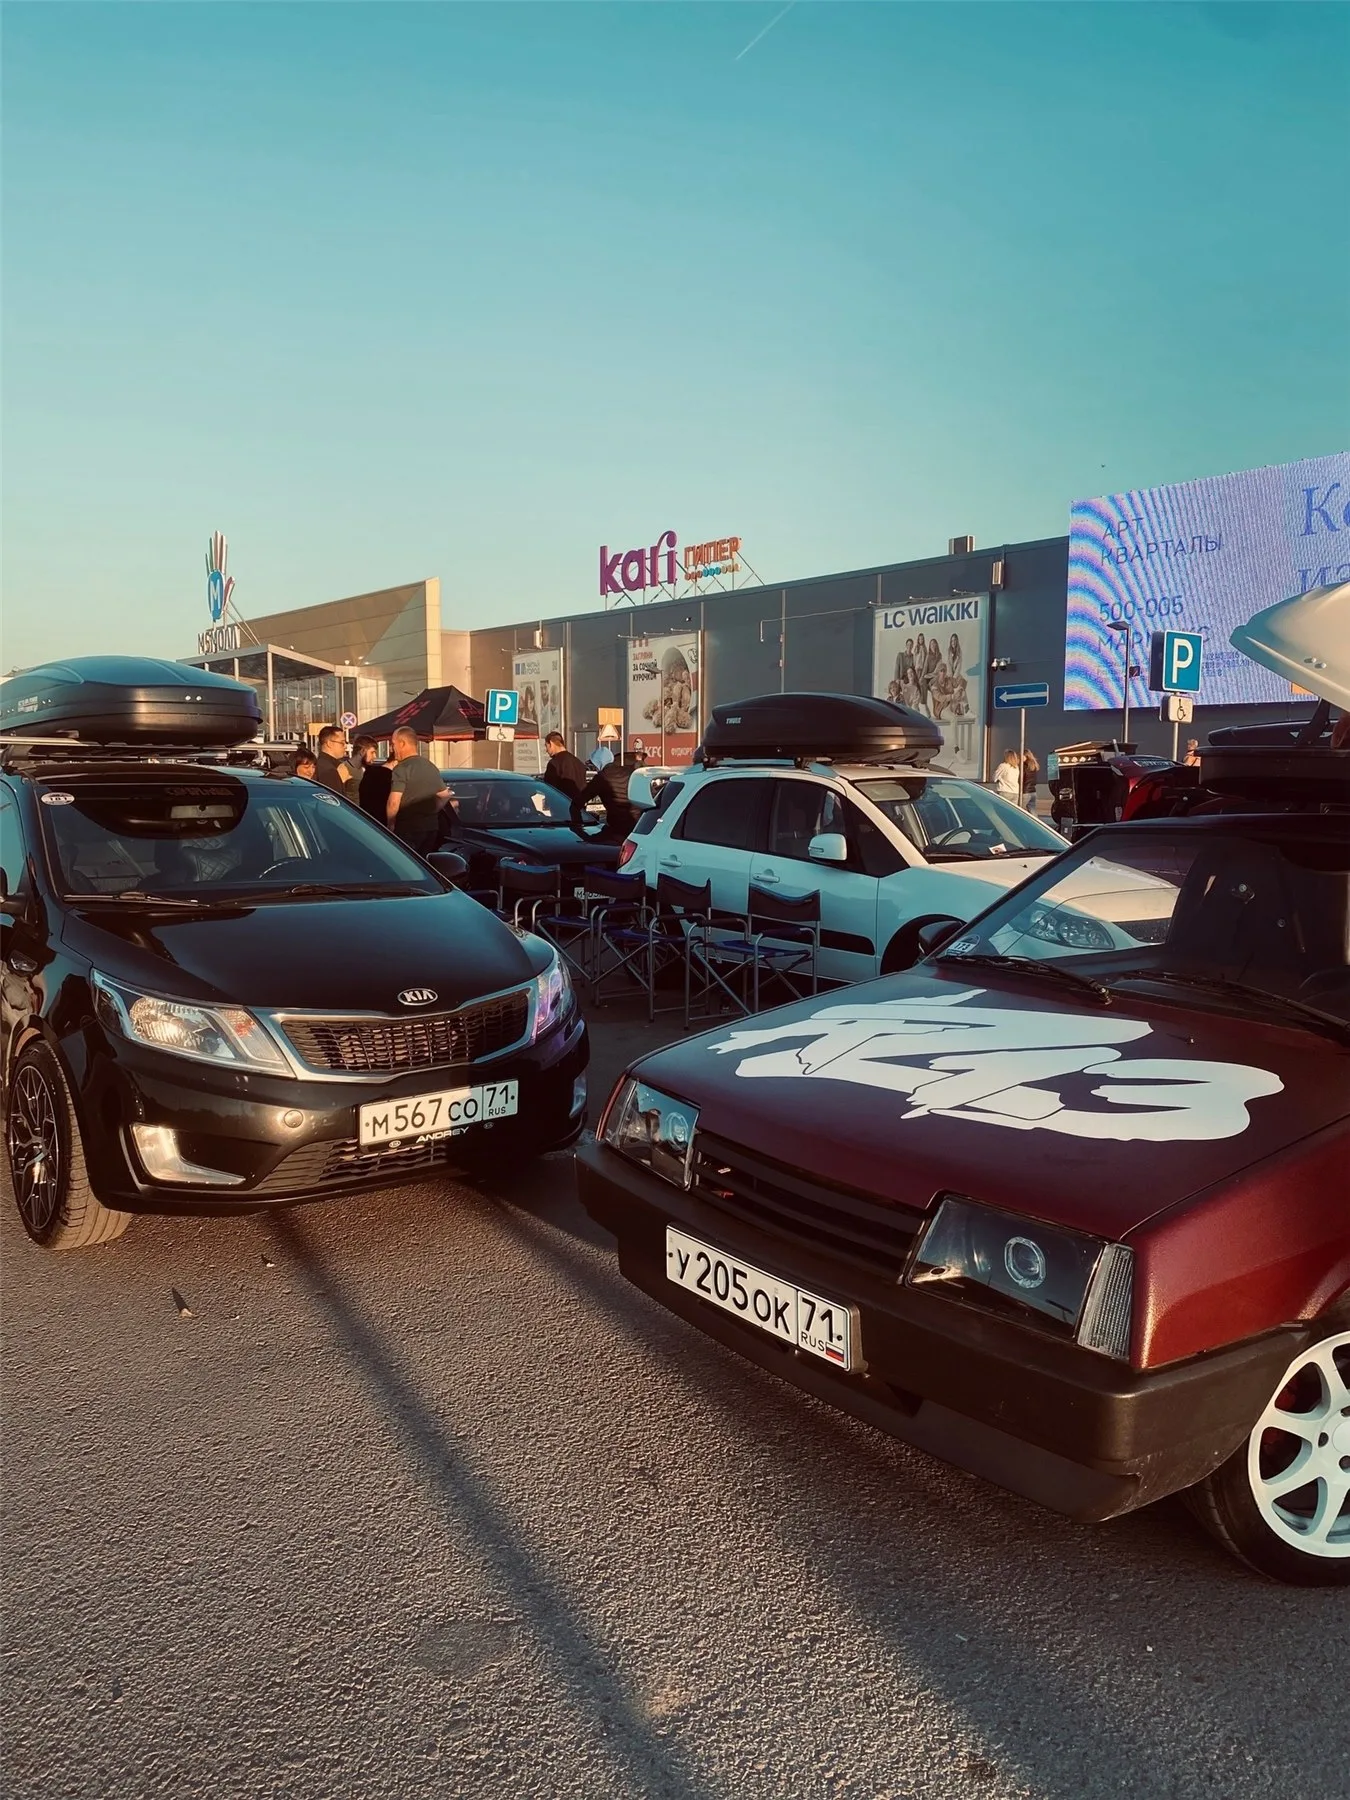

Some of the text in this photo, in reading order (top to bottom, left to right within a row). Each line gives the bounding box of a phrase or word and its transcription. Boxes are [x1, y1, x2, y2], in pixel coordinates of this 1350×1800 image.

[1102, 517, 1144, 541] АРТ
[684, 536, 740, 569] ГИПЕР
[1101, 533, 1222, 566] КВАРТАЛЫ
[600, 530, 677, 596] kari
[884, 610, 905, 629] LC
[1100, 595, 1183, 622] 500-005
[1172, 637, 1194, 684] P
[495, 693, 512, 719] P
[402, 989, 435, 1002] KIA
[486, 1085, 509, 1108] 71
[488, 1107, 507, 1117] RUS
[416, 1126, 469, 1143] ANDREY
[802, 1297, 834, 1343] 71
[801, 1331, 825, 1352] RUS
